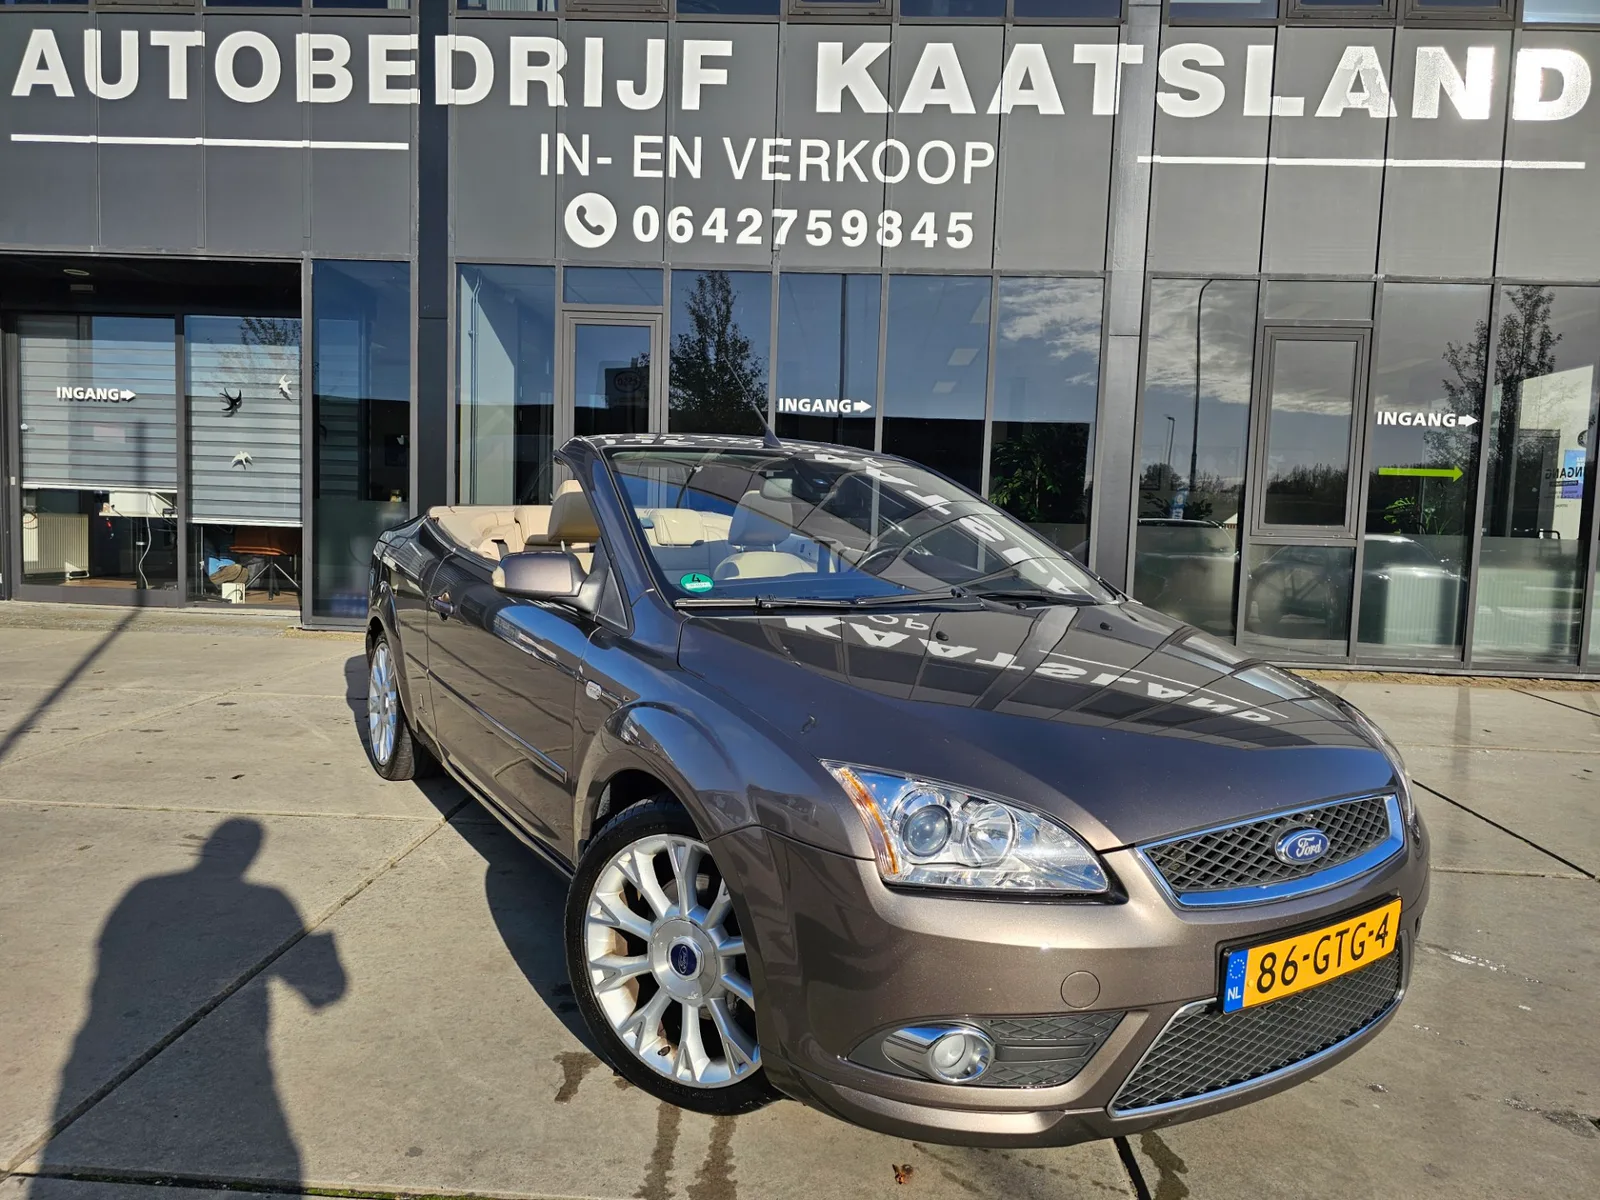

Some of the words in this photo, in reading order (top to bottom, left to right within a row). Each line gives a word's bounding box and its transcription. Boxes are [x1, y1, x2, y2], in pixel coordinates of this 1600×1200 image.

[11, 27, 734, 111] AUTOBEDRIJF
[816, 41, 1592, 121] KAATSLAND
[540, 132, 613, 177] IN-
[633, 134, 702, 179] EN
[722, 137, 996, 185] VERKOOP
[632, 204, 974, 249] 0642759845
[56, 386, 120, 402] INGANG
[778, 398, 852, 414] INGANG
[1376, 411, 1457, 428] INGANG
[1295, 836, 1322, 858] Ford
[1256, 912, 1390, 994] 86-GTG-4
[1227, 986, 1242, 1001] NL
